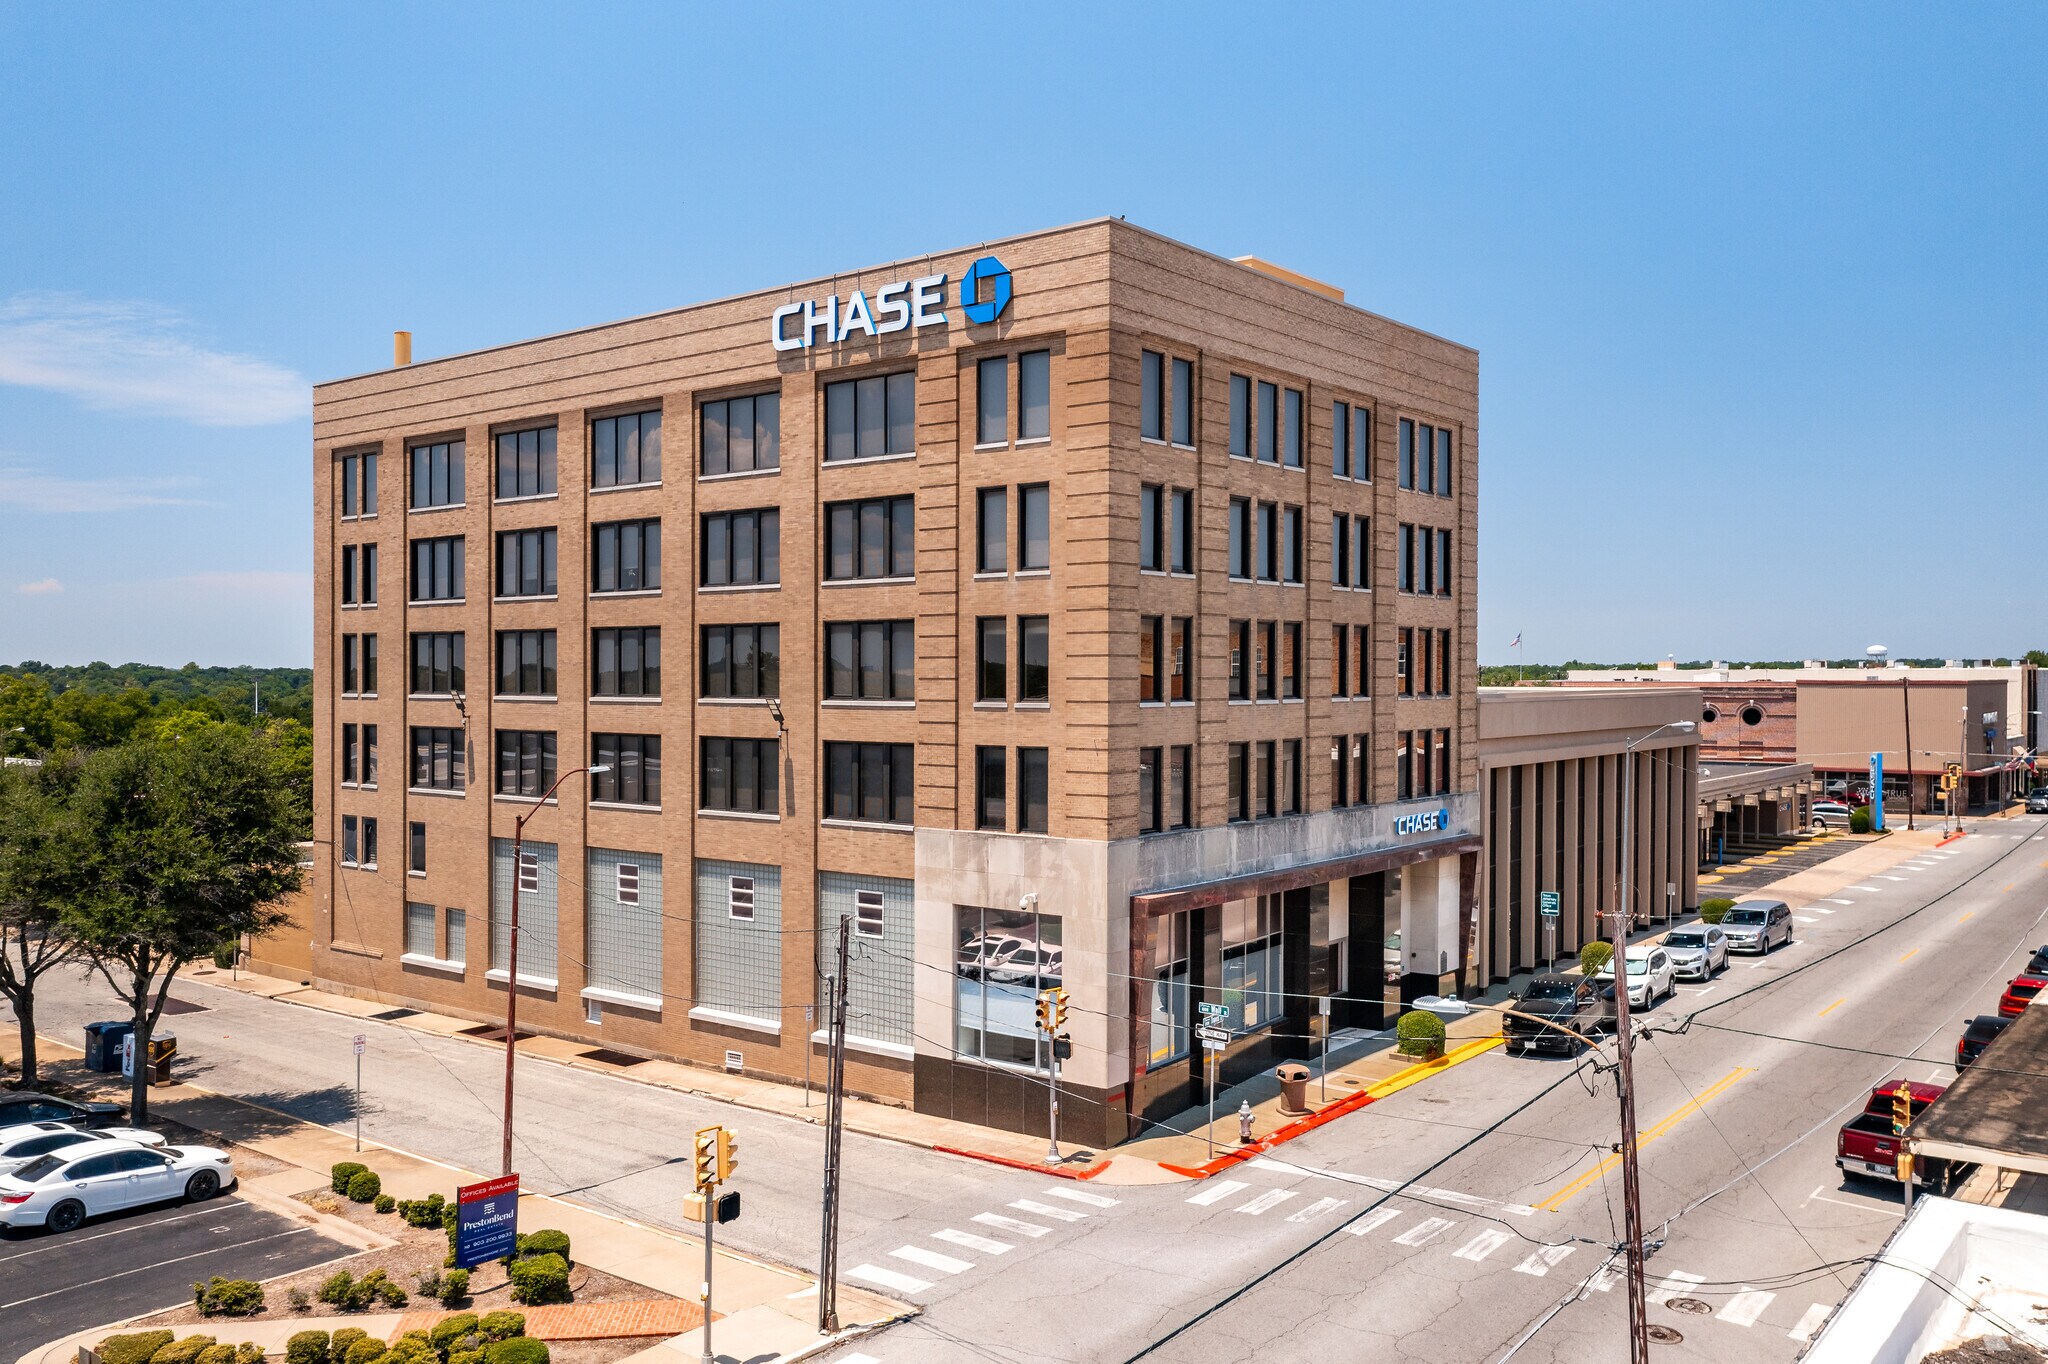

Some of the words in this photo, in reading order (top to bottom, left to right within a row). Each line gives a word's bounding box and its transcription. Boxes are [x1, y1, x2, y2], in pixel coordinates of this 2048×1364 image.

[772, 273, 948, 352] CHASE
[1395, 811, 1439, 836] CHASE
[1874, 1147, 1893, 1156] GMC
[461, 1188, 487, 1199] OFFICES
[488, 1180, 519, 1192] AVAILABLE
[463, 1208, 514, 1232] PrestonBend
